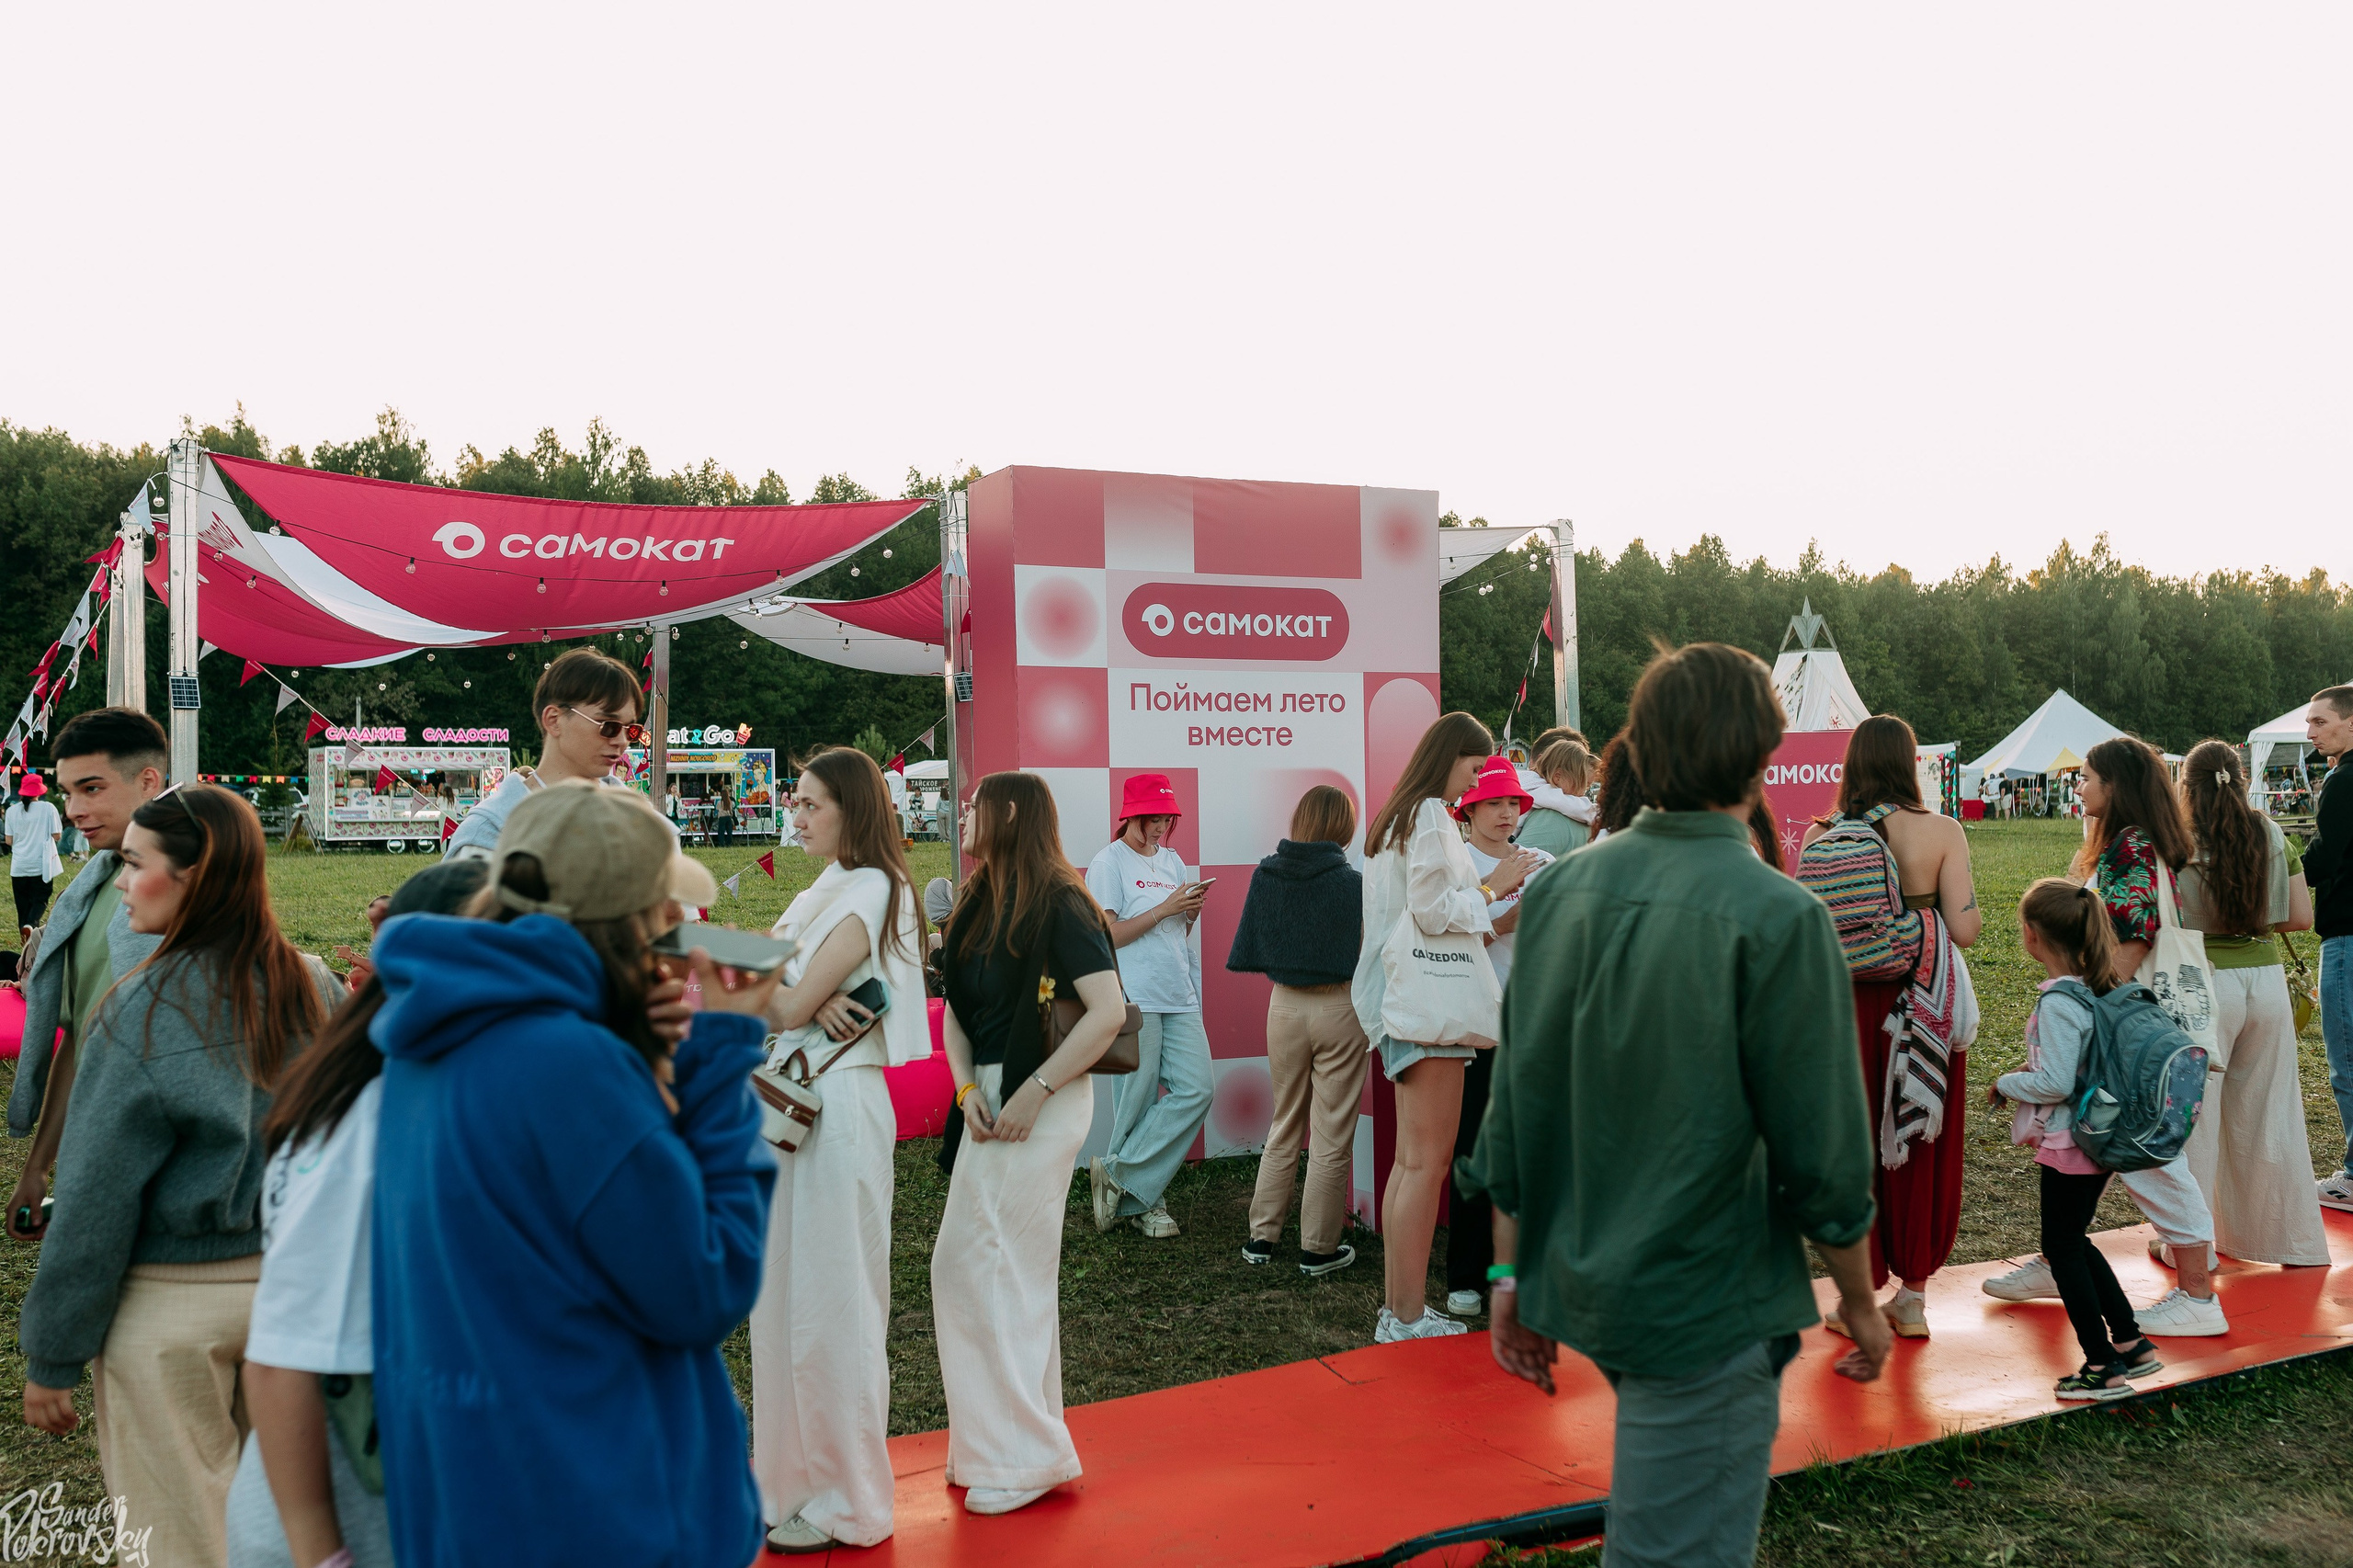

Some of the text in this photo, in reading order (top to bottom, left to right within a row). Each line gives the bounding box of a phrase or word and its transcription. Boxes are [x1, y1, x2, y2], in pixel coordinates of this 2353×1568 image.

[499, 533, 735, 562] самокат
[1183, 611, 1333, 638] самокат
[1130, 682, 1347, 713] Поймаем лето
[325, 726, 509, 743] СЛАДКИЕ СЛАДОСТИ
[667, 726, 688, 744] at
[704, 724, 735, 745] Go
[1188, 725, 1293, 747] вместе
[1763, 763, 1844, 785] амока
